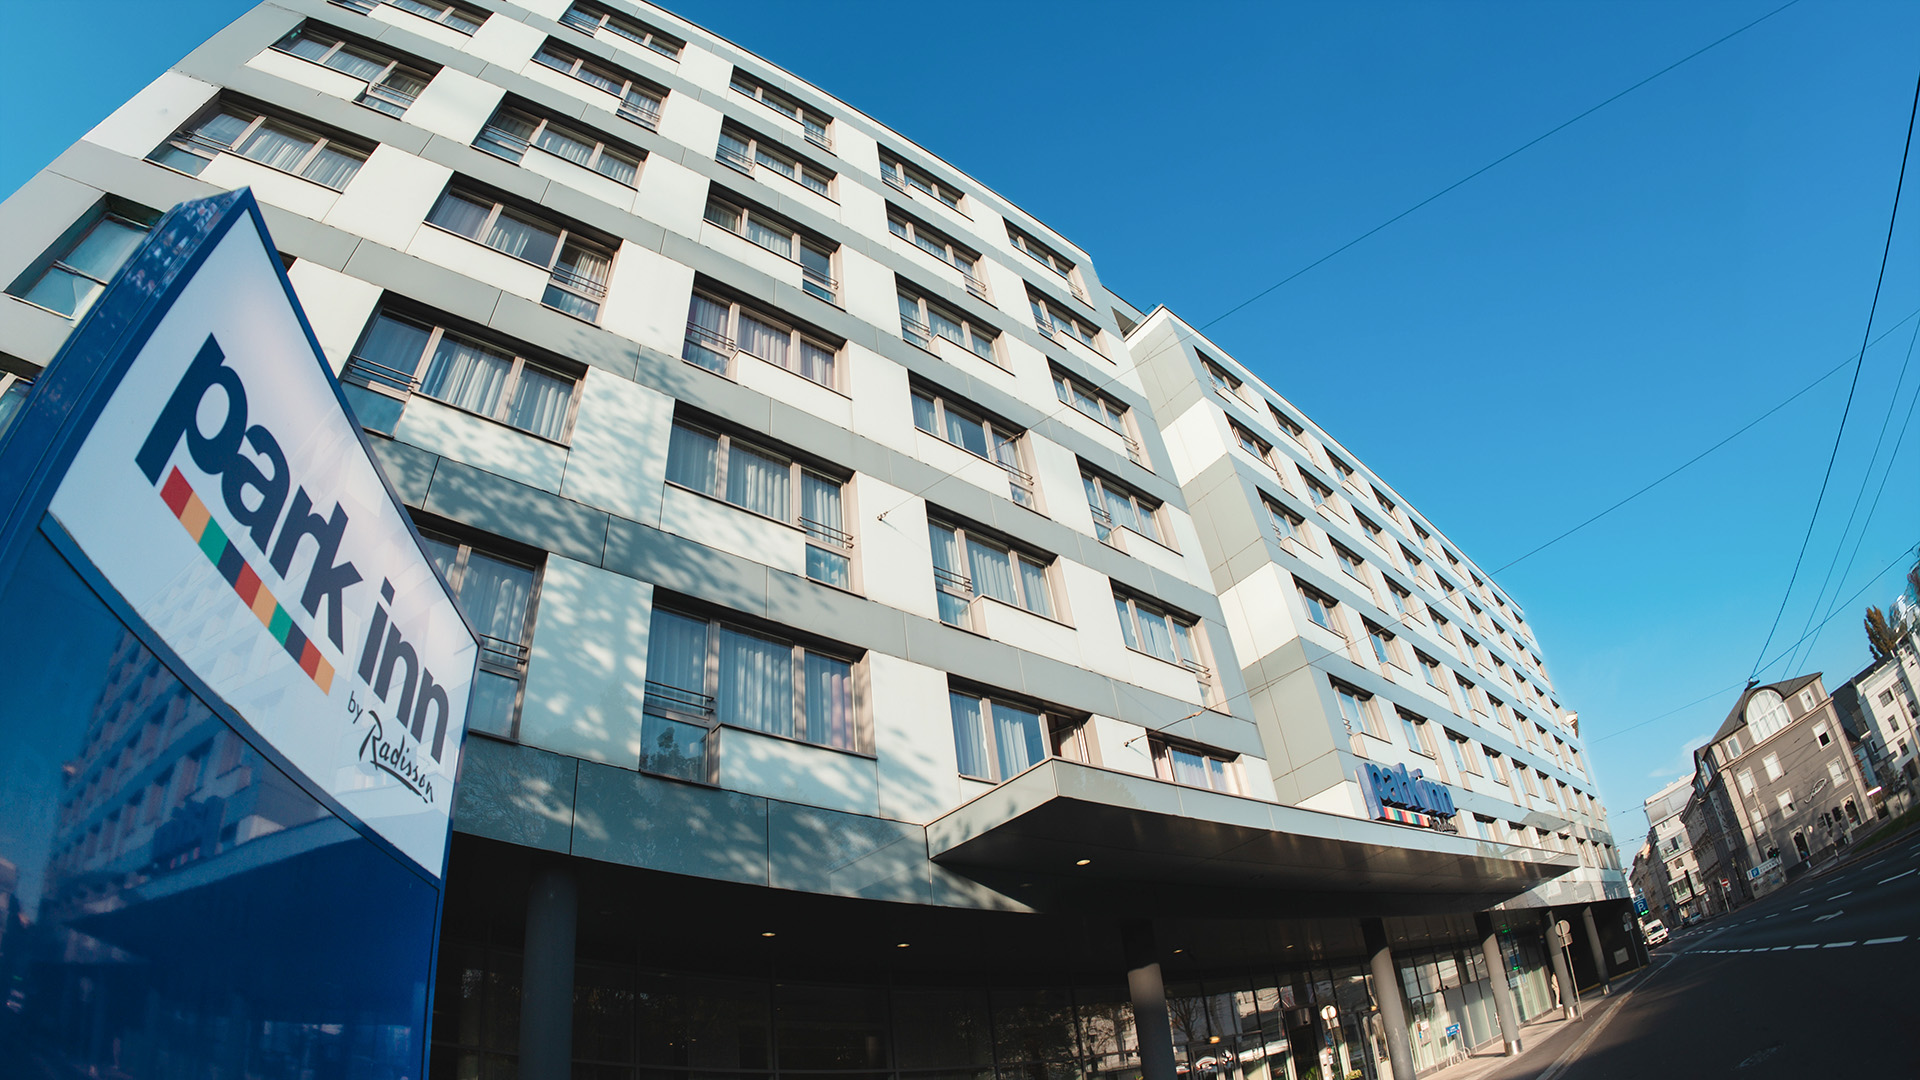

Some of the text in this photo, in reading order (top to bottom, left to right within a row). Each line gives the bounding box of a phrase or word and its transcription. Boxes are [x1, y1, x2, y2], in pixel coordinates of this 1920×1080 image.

[134, 332, 449, 764] park inn
[347, 690, 434, 804] by Radisson
[1356, 762, 1456, 820] park inn
